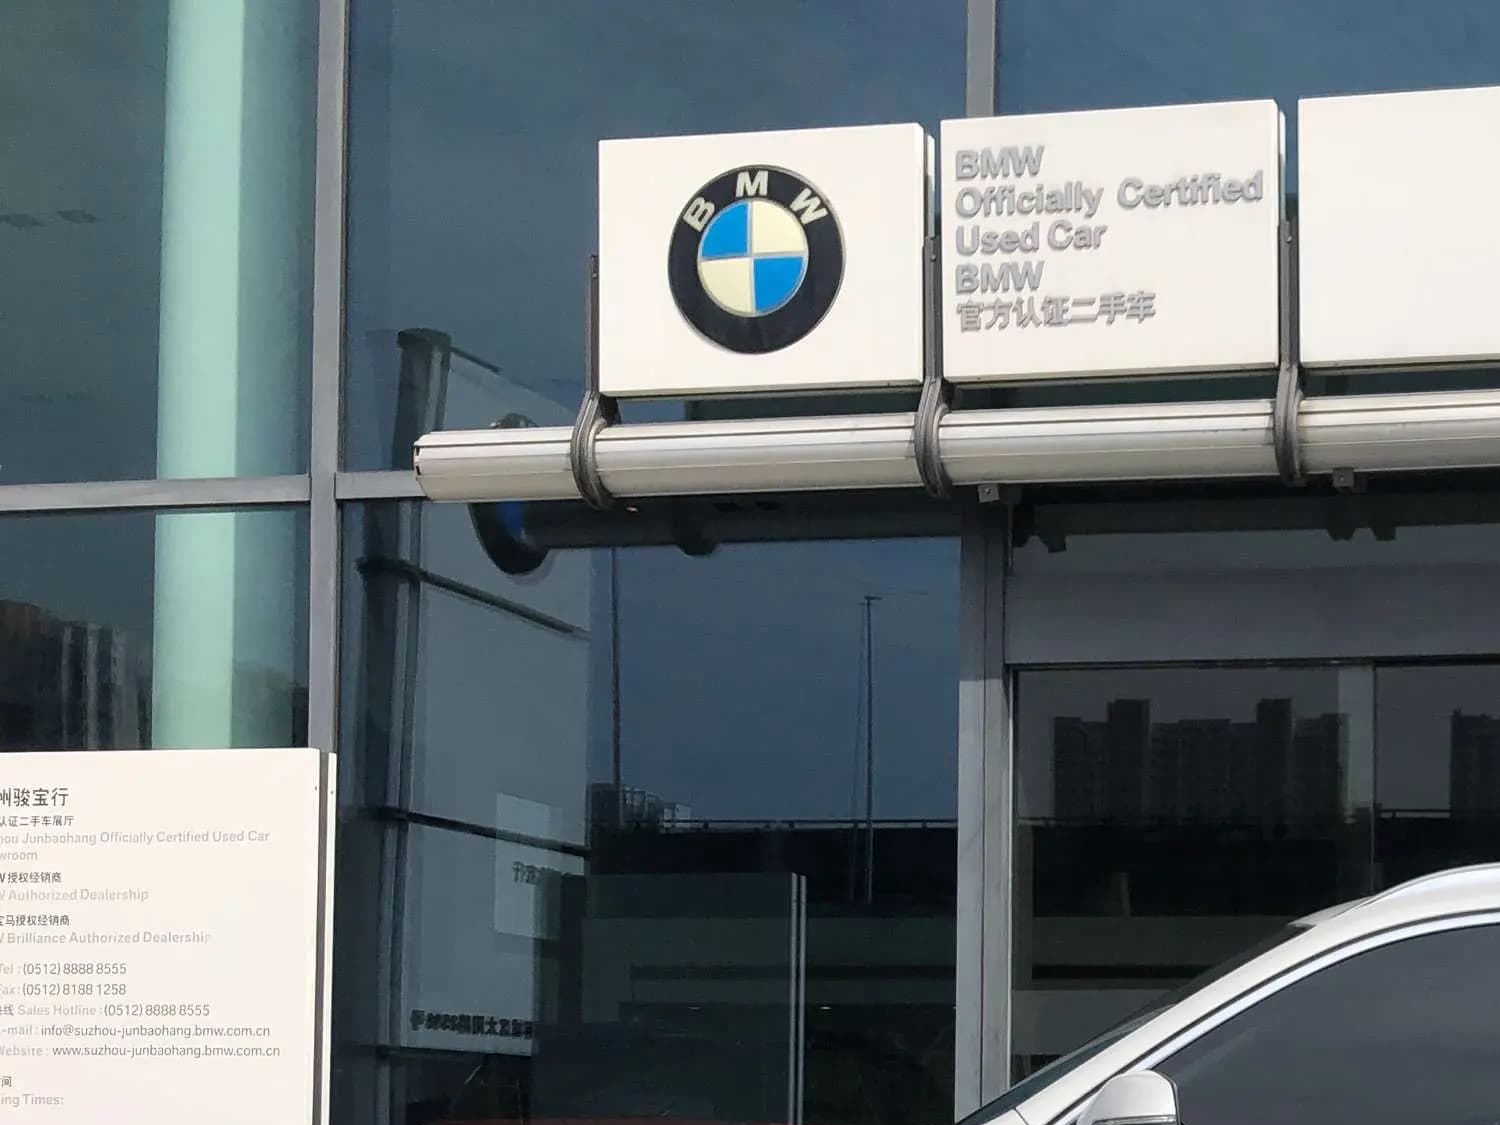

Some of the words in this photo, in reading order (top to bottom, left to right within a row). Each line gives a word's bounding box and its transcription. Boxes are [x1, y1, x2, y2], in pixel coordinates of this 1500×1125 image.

[956, 146, 1044, 180] BMW
[685, 170, 829, 232] BMW
[956, 180, 1103, 219] Officially
[1118, 170, 1263, 208] Certified
[956, 223, 1039, 256] Used
[1048, 218, 1107, 250] Car
[956, 261, 1044, 294] BMW
[956, 291, 1156, 331] 官方认证二手车
[22, 833, 97, 845] Junbaohang
[100, 832, 154, 845] Officially
[156, 831, 209, 843] Certified
[212, 831, 244, 842] Used
[248, 830, 269, 842] Car
[8, 889, 77, 901] Authorized
[80, 888, 149, 902] Dealership
[8, 932, 66, 944] Brilliance
[69, 931, 140, 944] Authorized
[63, 963, 94, 975] 8888
[96, 963, 126, 975] 8555
[63, 983, 93, 996] 8188
[97, 983, 126, 996] 1258
[17, 1005, 50, 1016] Sales
[145, 1004, 176, 1016] 8888
[179, 1004, 210, 1016] 8555
[41, 1025, 270, 1038] info@suzhou-junbaohang.bmw.com.cn
[52, 1045, 280, 1058] www.suzhou-junbaohang.bmw.com.cn
[22, 1094, 64, 1105] Times:
